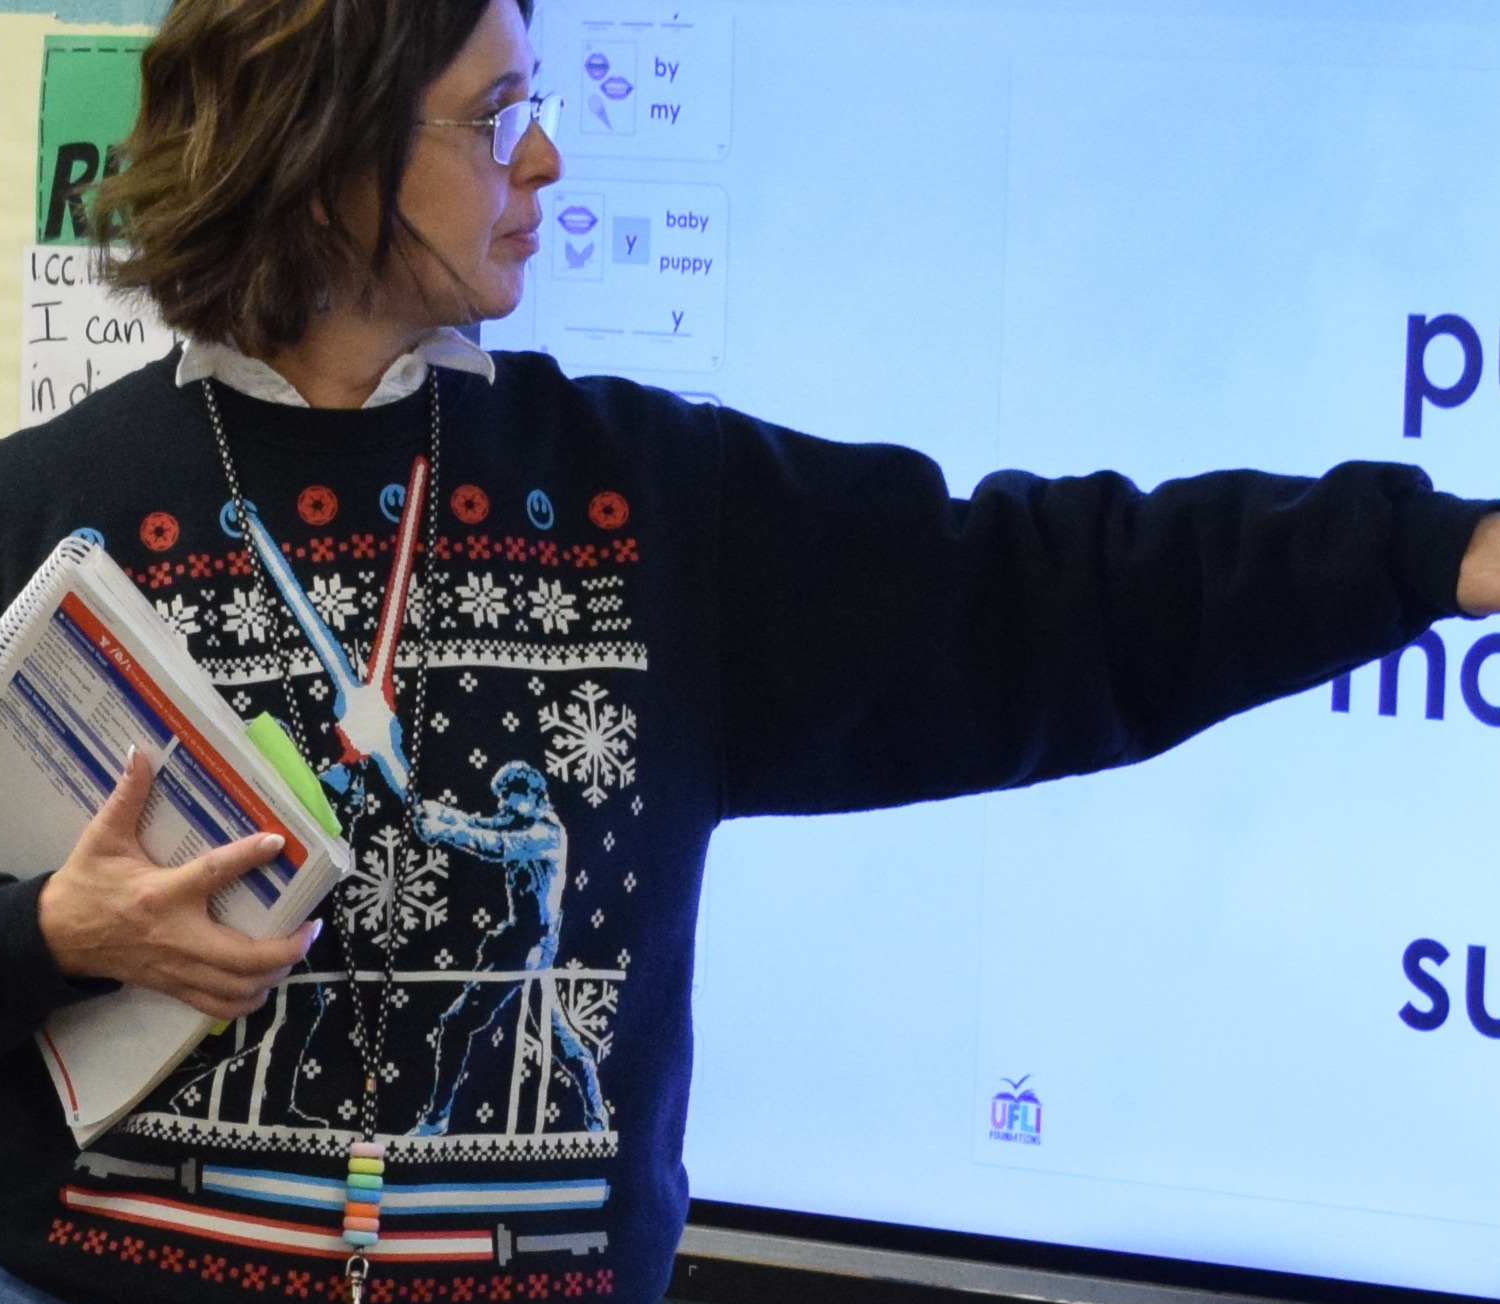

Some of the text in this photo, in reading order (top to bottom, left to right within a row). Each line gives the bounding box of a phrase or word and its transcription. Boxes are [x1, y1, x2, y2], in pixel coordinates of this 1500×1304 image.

[654, 57, 679, 83] by
[650, 102, 681, 125] my
[666, 210, 709, 233] baby
[625, 233, 713, 276] y puppy
[29, 301, 145, 346] I can
[671, 309, 685, 334] y
[31, 363, 55, 413] in
